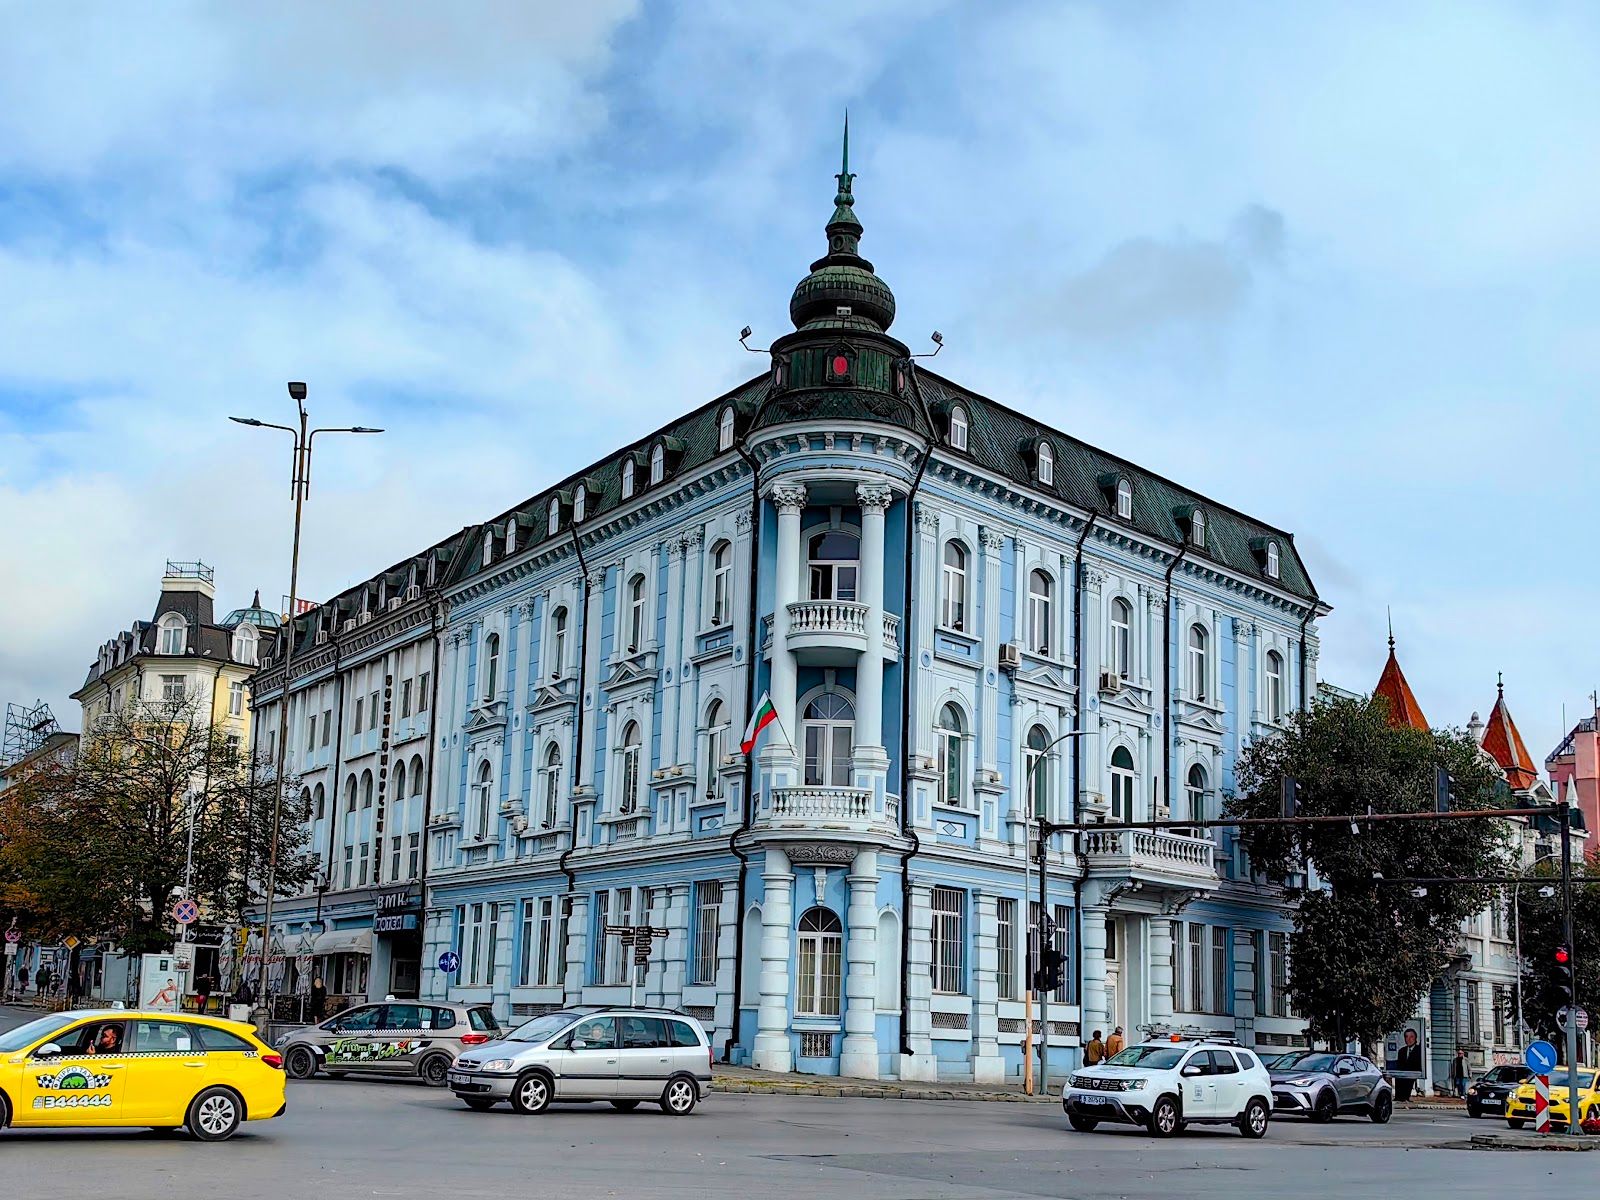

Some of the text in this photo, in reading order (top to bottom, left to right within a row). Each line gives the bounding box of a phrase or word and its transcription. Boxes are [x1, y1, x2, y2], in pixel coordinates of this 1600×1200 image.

[57, 1066, 94, 1083] HIPPO TAXI
[44, 1094, 112, 1108] 344444
